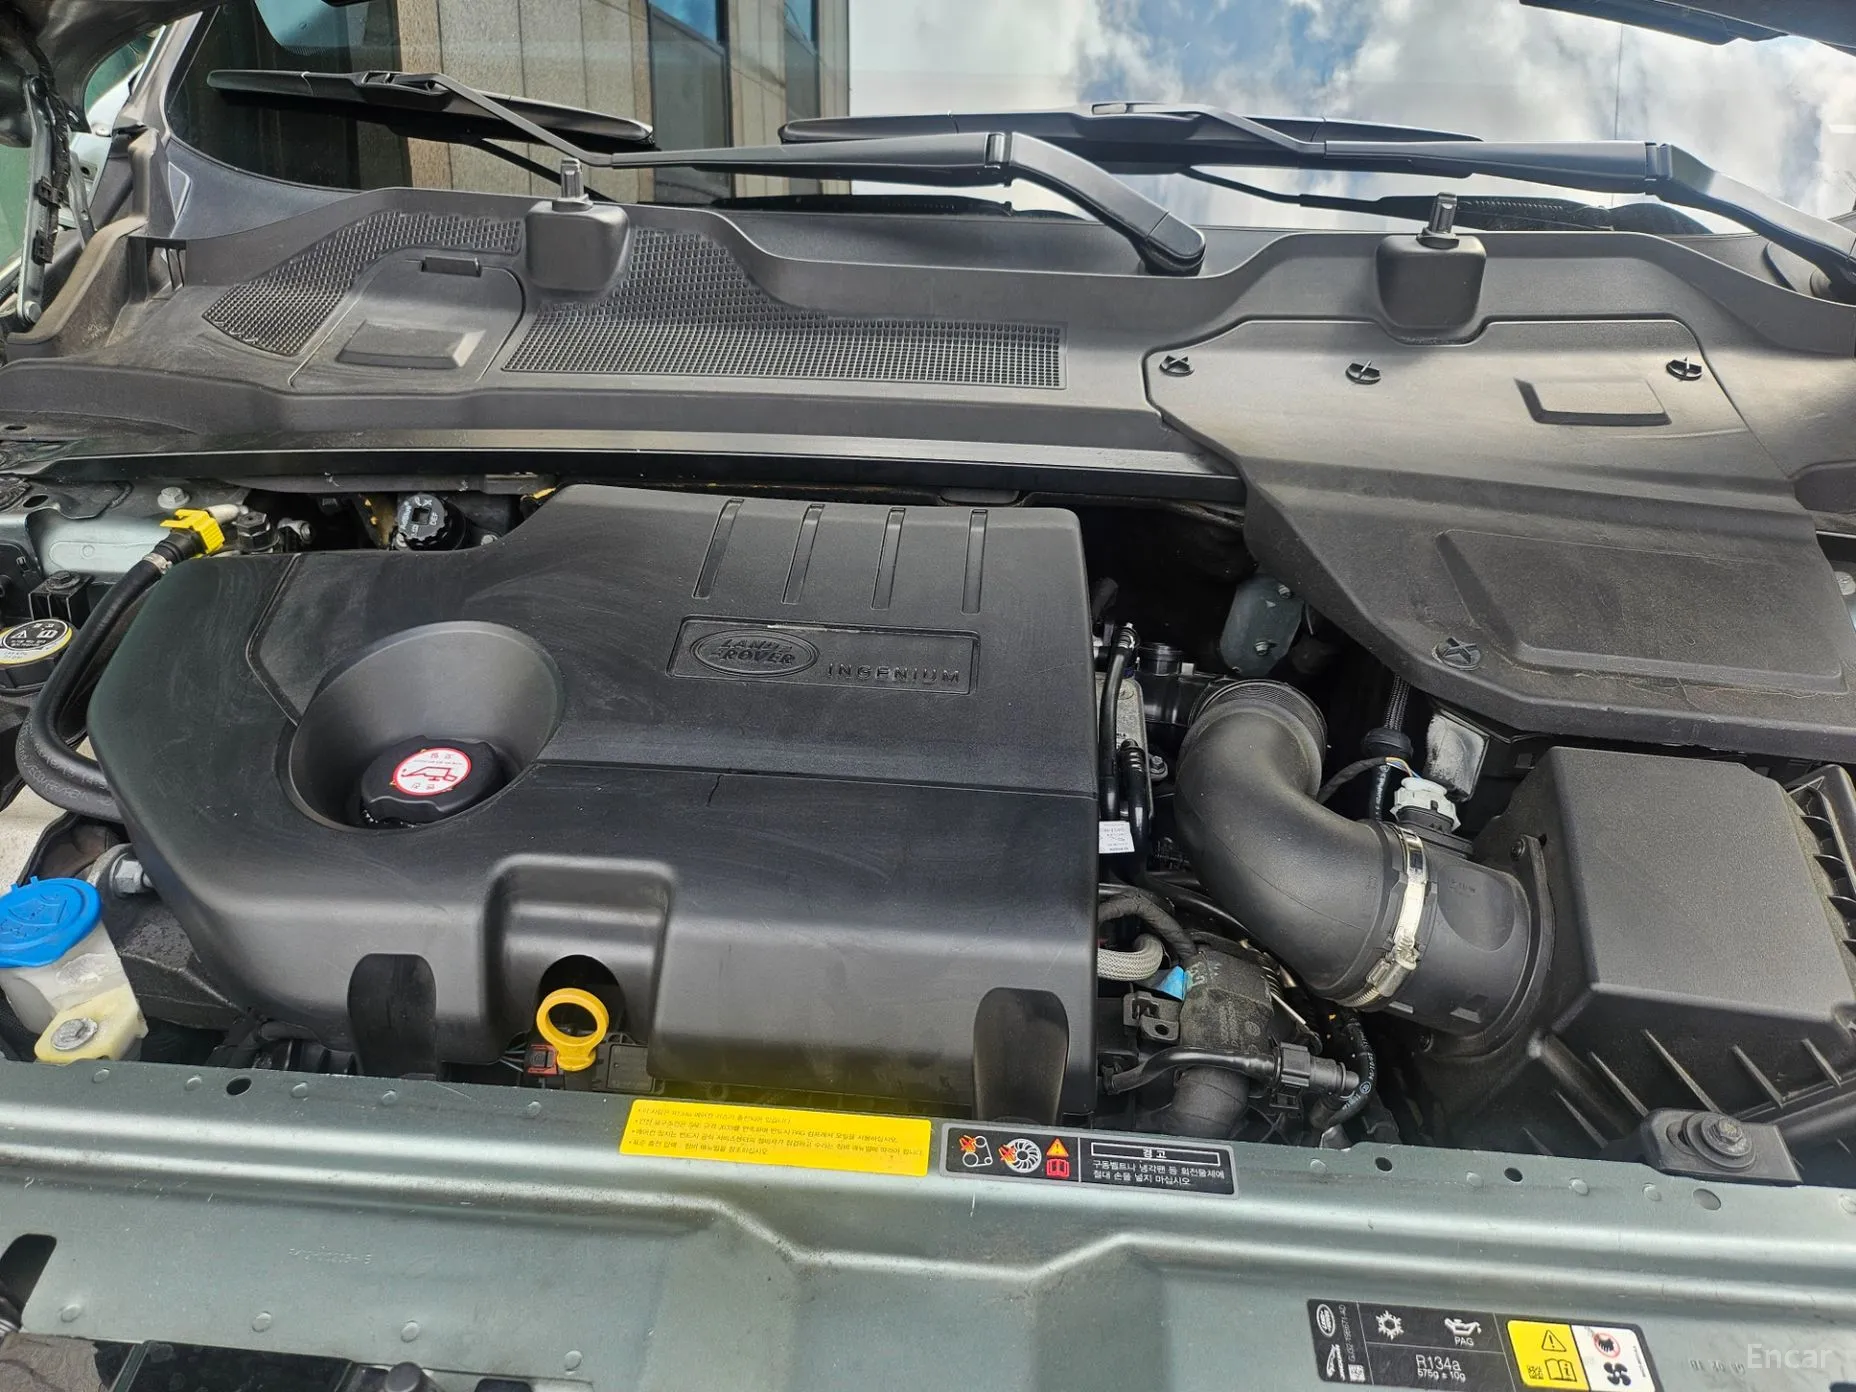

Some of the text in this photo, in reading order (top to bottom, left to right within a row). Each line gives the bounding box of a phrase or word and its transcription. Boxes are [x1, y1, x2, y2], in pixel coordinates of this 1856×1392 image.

[722, 650, 796, 665] ROVER
[827, 662, 961, 684] INGENIUM
[1093, 1159, 1225, 1179] 구동벨트나 냉각팬 등 회전물체에
[1093, 1169, 1191, 1185] 절대 손을 넣지 마십시오
[1454, 1336, 1474, 1347] PAG
[1416, 1354, 1462, 1372] R134a
